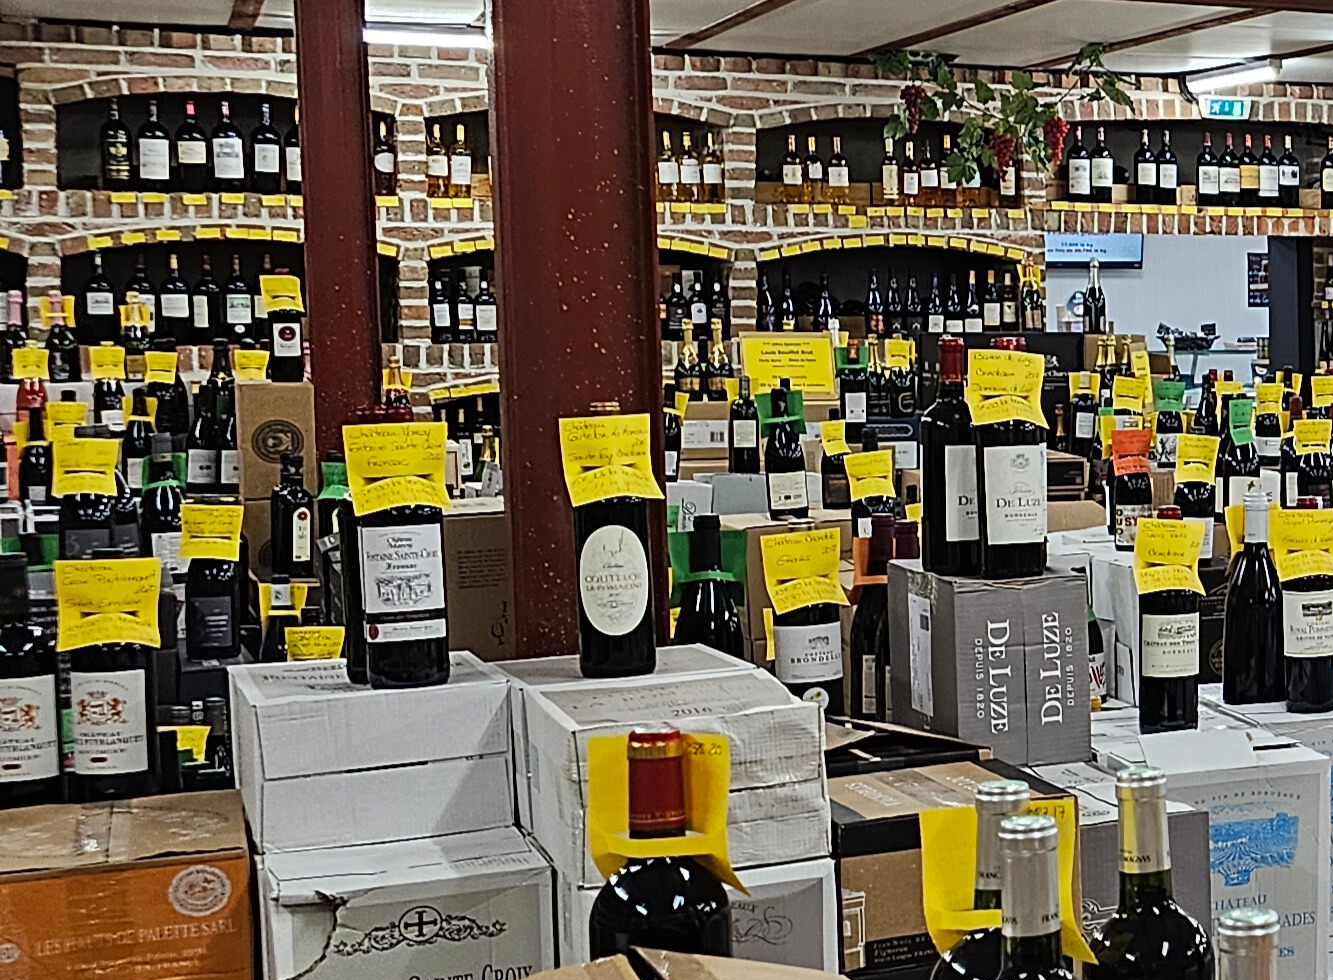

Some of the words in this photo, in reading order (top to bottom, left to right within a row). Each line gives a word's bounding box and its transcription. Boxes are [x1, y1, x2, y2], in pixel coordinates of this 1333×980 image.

[996, 498, 1014, 508] DE
[975, 638, 984, 680] DEPUIS
[987, 619, 1010, 661] DE
[1040, 611, 1062, 679] LUZE
[1065, 627, 1073, 658] 1820
[976, 688, 984, 718] 1820
[988, 665, 1012, 734] LUZE
[1041, 685, 1062, 726] DE
[1066, 664, 1075, 706] DEPUIS
[138, 923, 201, 944] PALETTE
[202, 920, 237, 935] SARL
